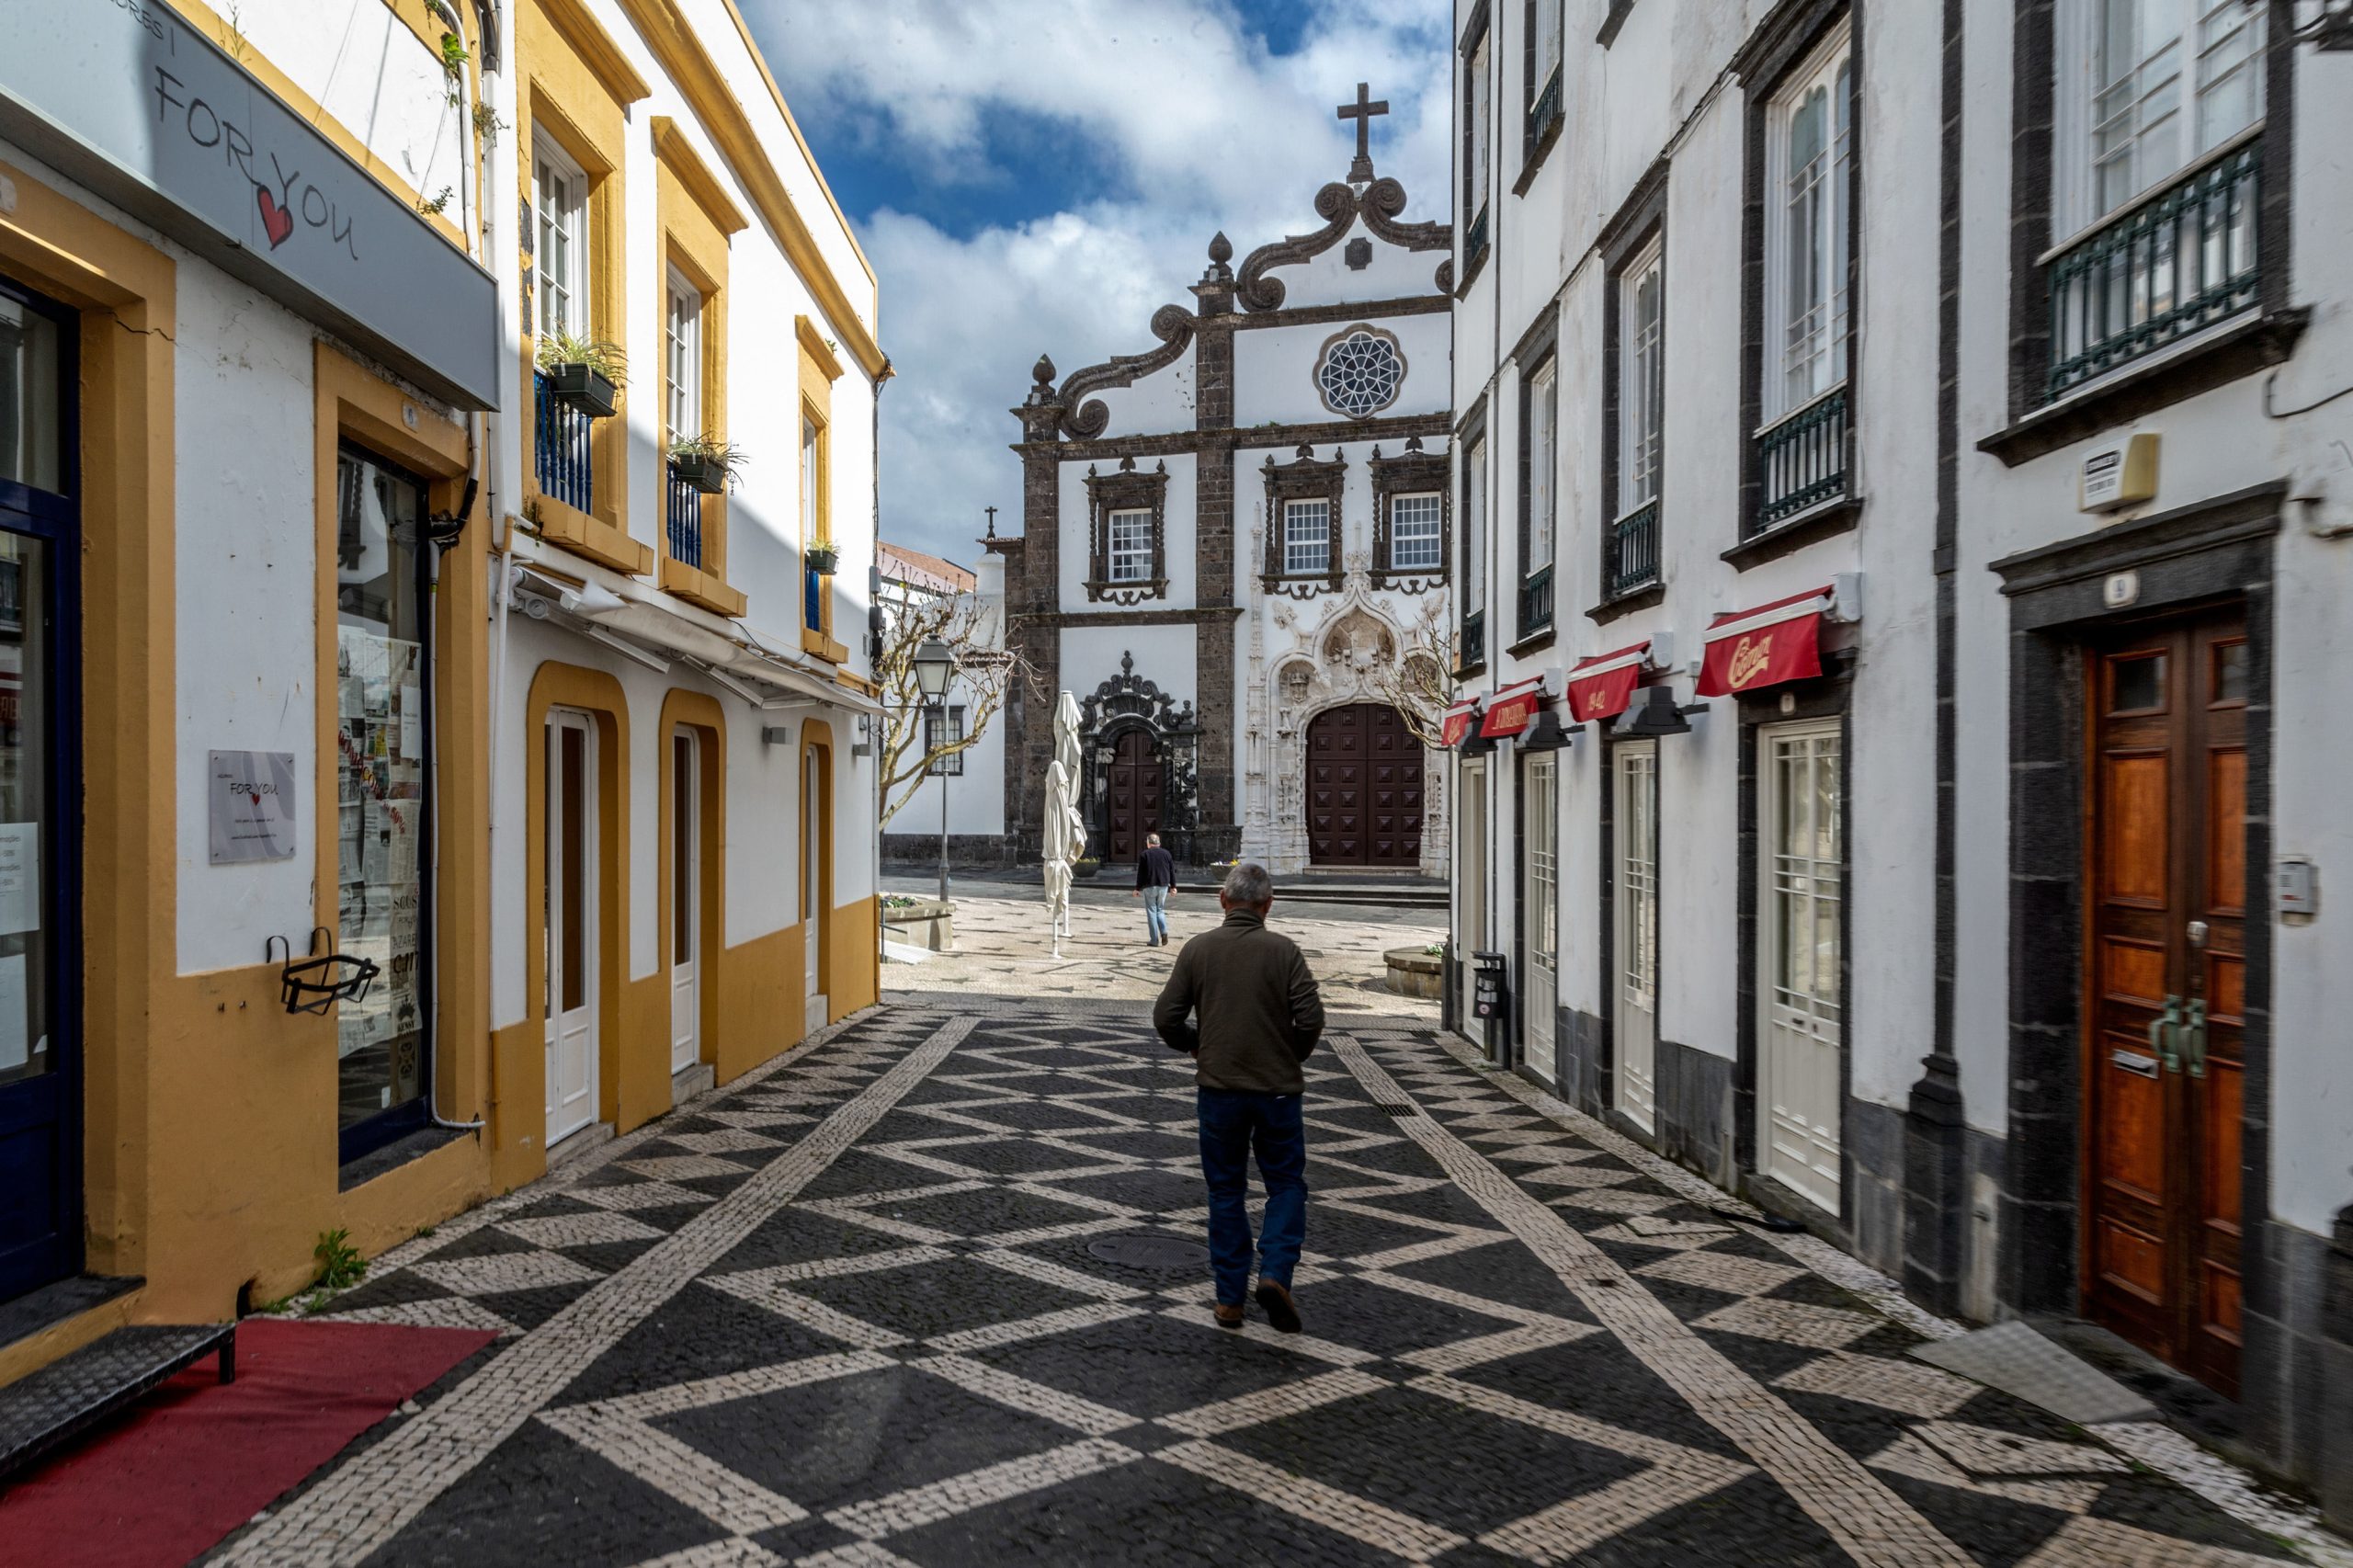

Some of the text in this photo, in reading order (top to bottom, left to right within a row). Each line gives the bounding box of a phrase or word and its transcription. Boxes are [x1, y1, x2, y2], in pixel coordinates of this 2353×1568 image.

[111, 0, 164, 40] ORES
[155, 66, 358, 260] FOR YOU
[230, 782, 278, 795] FOR YOU
